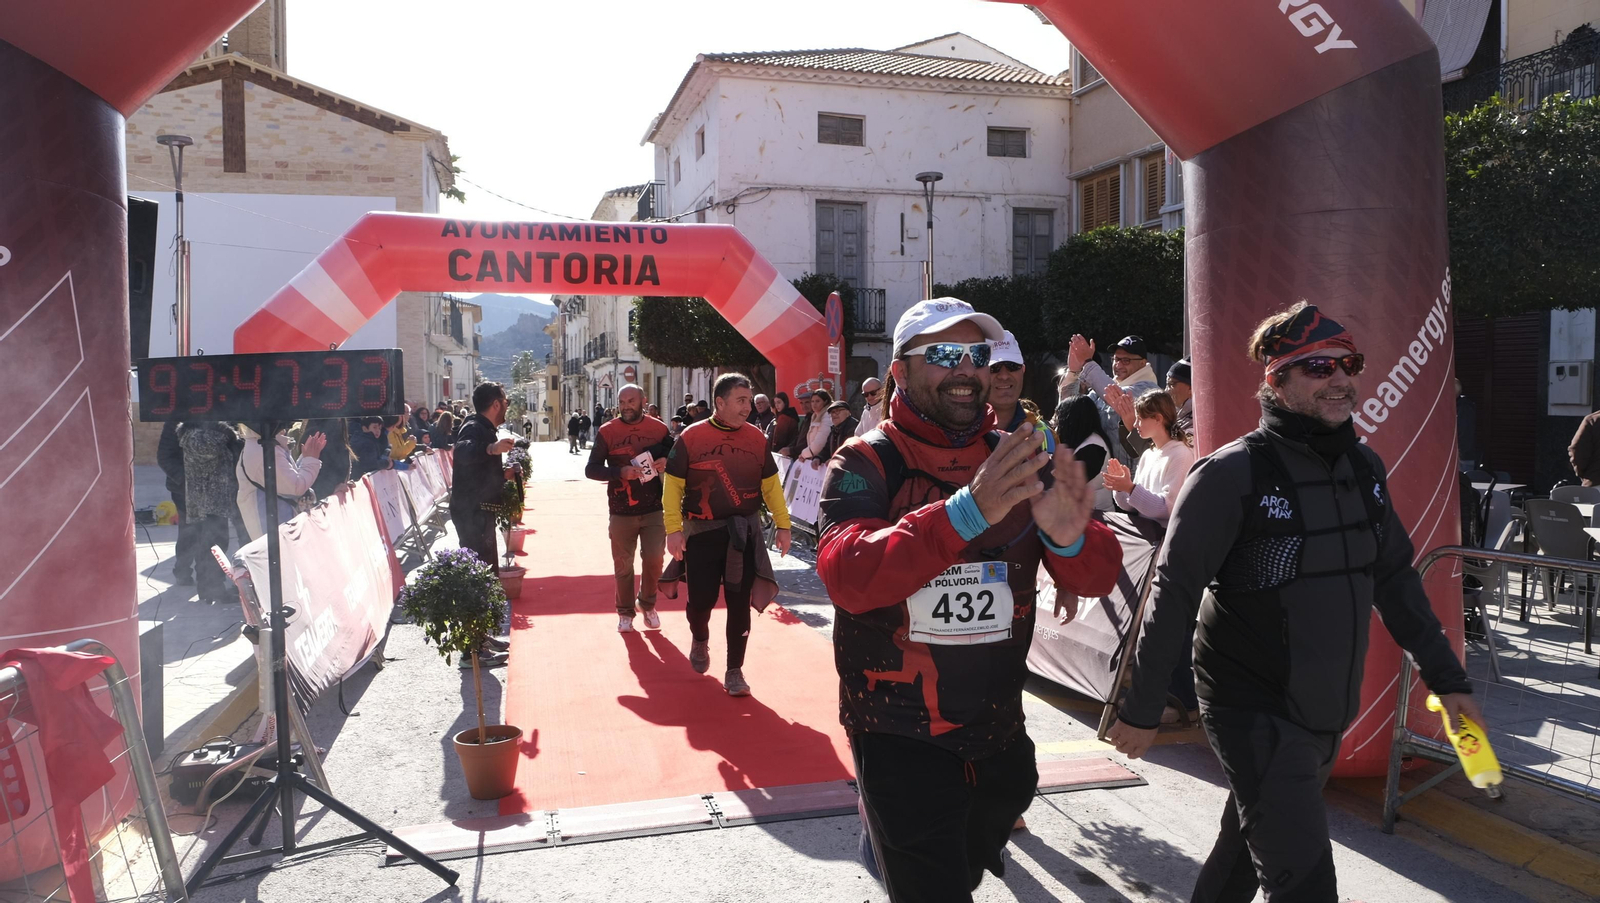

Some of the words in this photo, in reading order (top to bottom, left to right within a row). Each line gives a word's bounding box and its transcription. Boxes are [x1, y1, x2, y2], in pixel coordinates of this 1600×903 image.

[441, 219, 668, 244] AYUNTAMIENTO
[448, 248, 660, 286] CANTORIA
[1267, 506, 1293, 519] MAX
[935, 577, 980, 588] PÓLVORA
[931, 589, 996, 624] 432
